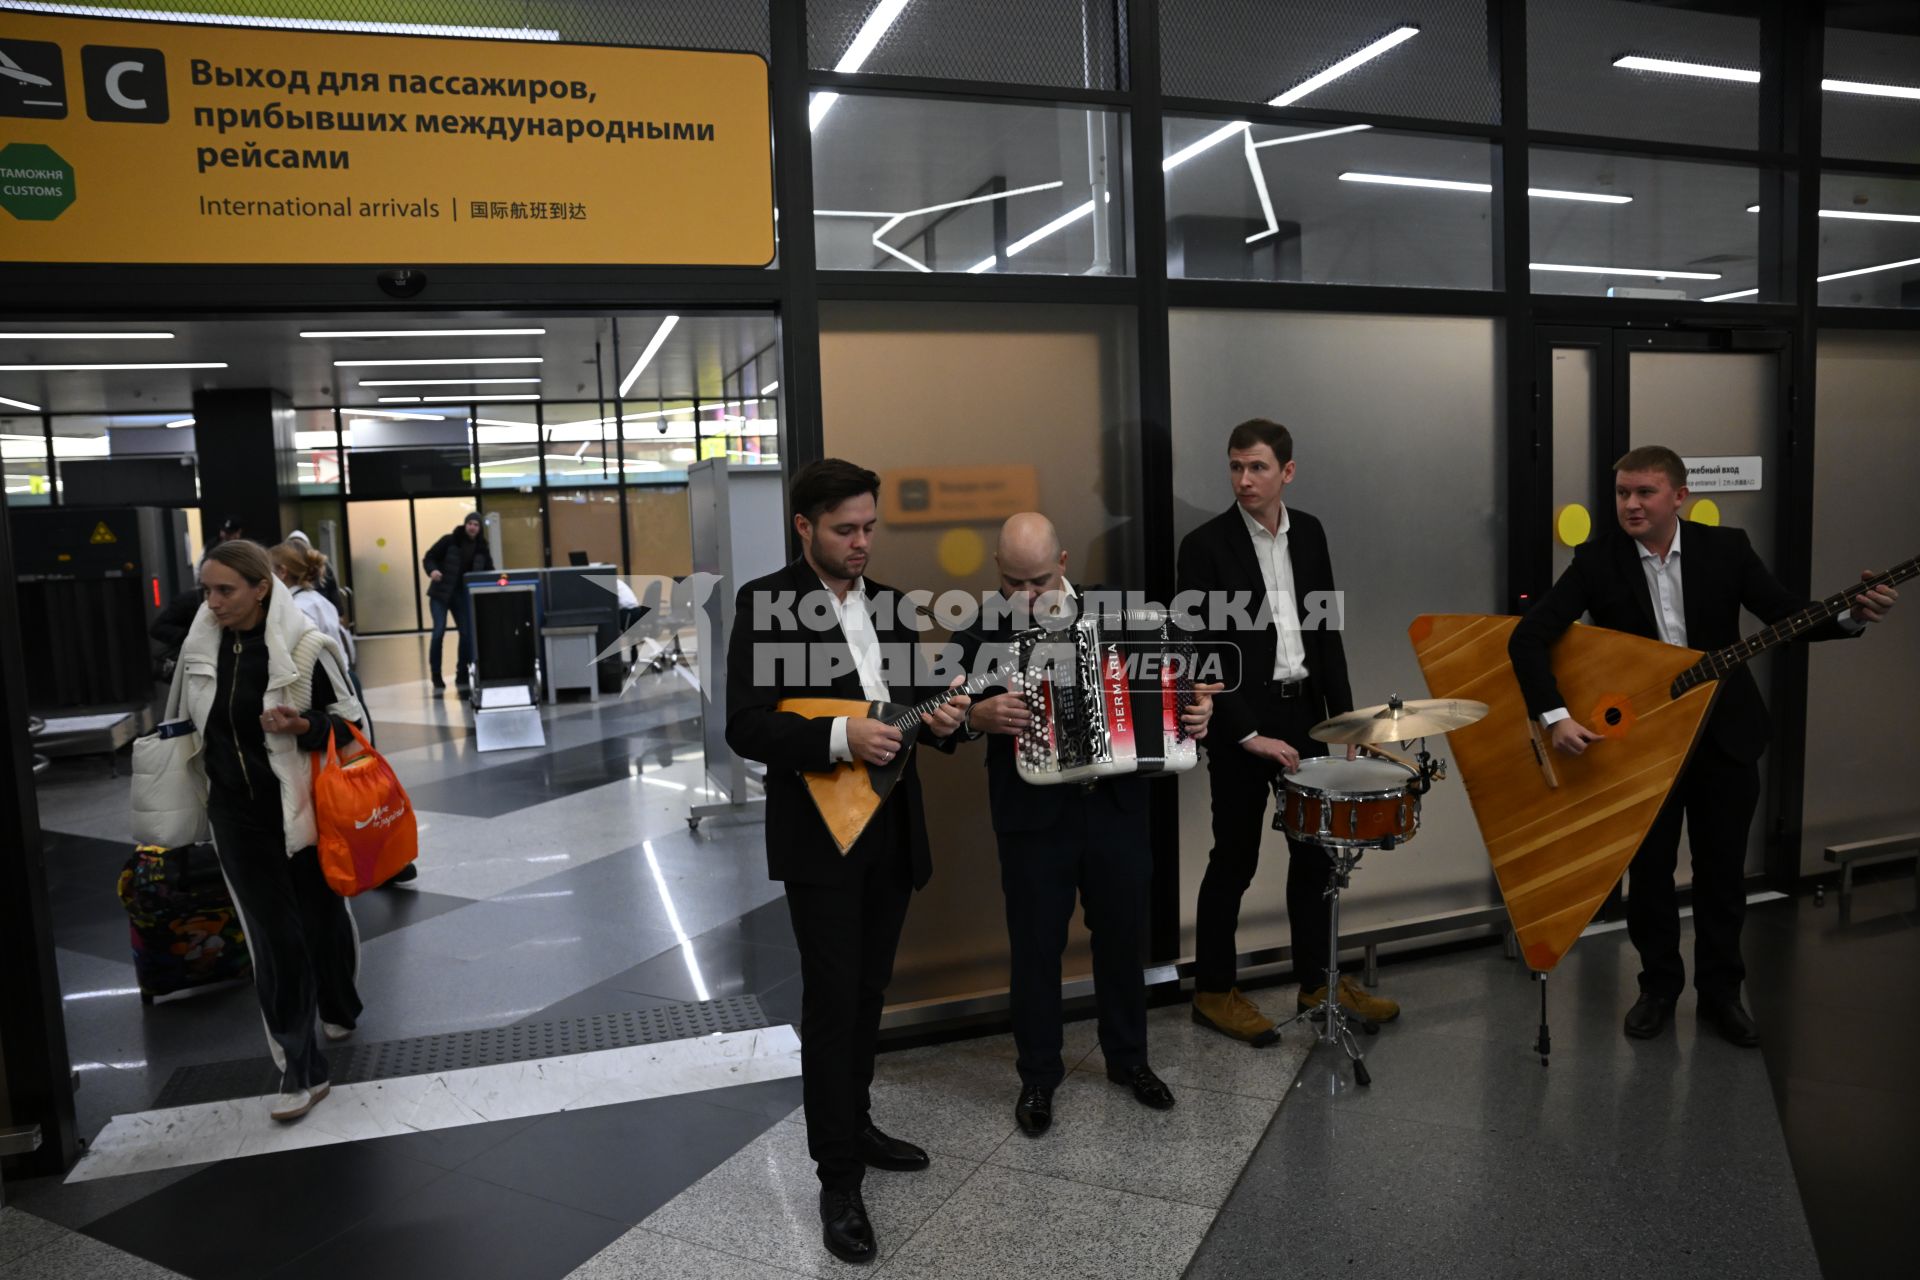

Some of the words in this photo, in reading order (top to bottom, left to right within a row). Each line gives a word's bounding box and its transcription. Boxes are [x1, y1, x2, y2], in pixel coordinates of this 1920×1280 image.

[105, 61, 147, 110] C
[190, 58, 311, 95] Выход
[317, 71, 380, 96] для
[388, 73, 597, 104] пассажиров,
[194, 102, 408, 134] прибывших
[415, 113, 715, 143] международными
[197, 141, 350, 173] рейсами
[0, 168, 63, 180] ТАМОЖНЯ
[3, 185, 63, 197] CUSTOMS
[199, 196, 351, 217] International
[359, 198, 440, 218] arrivals
[470, 201, 587, 220] 国际航班到达
[1686, 465, 1720, 475] ужебный
[1107, 643, 1126, 732] PIERMARIA
